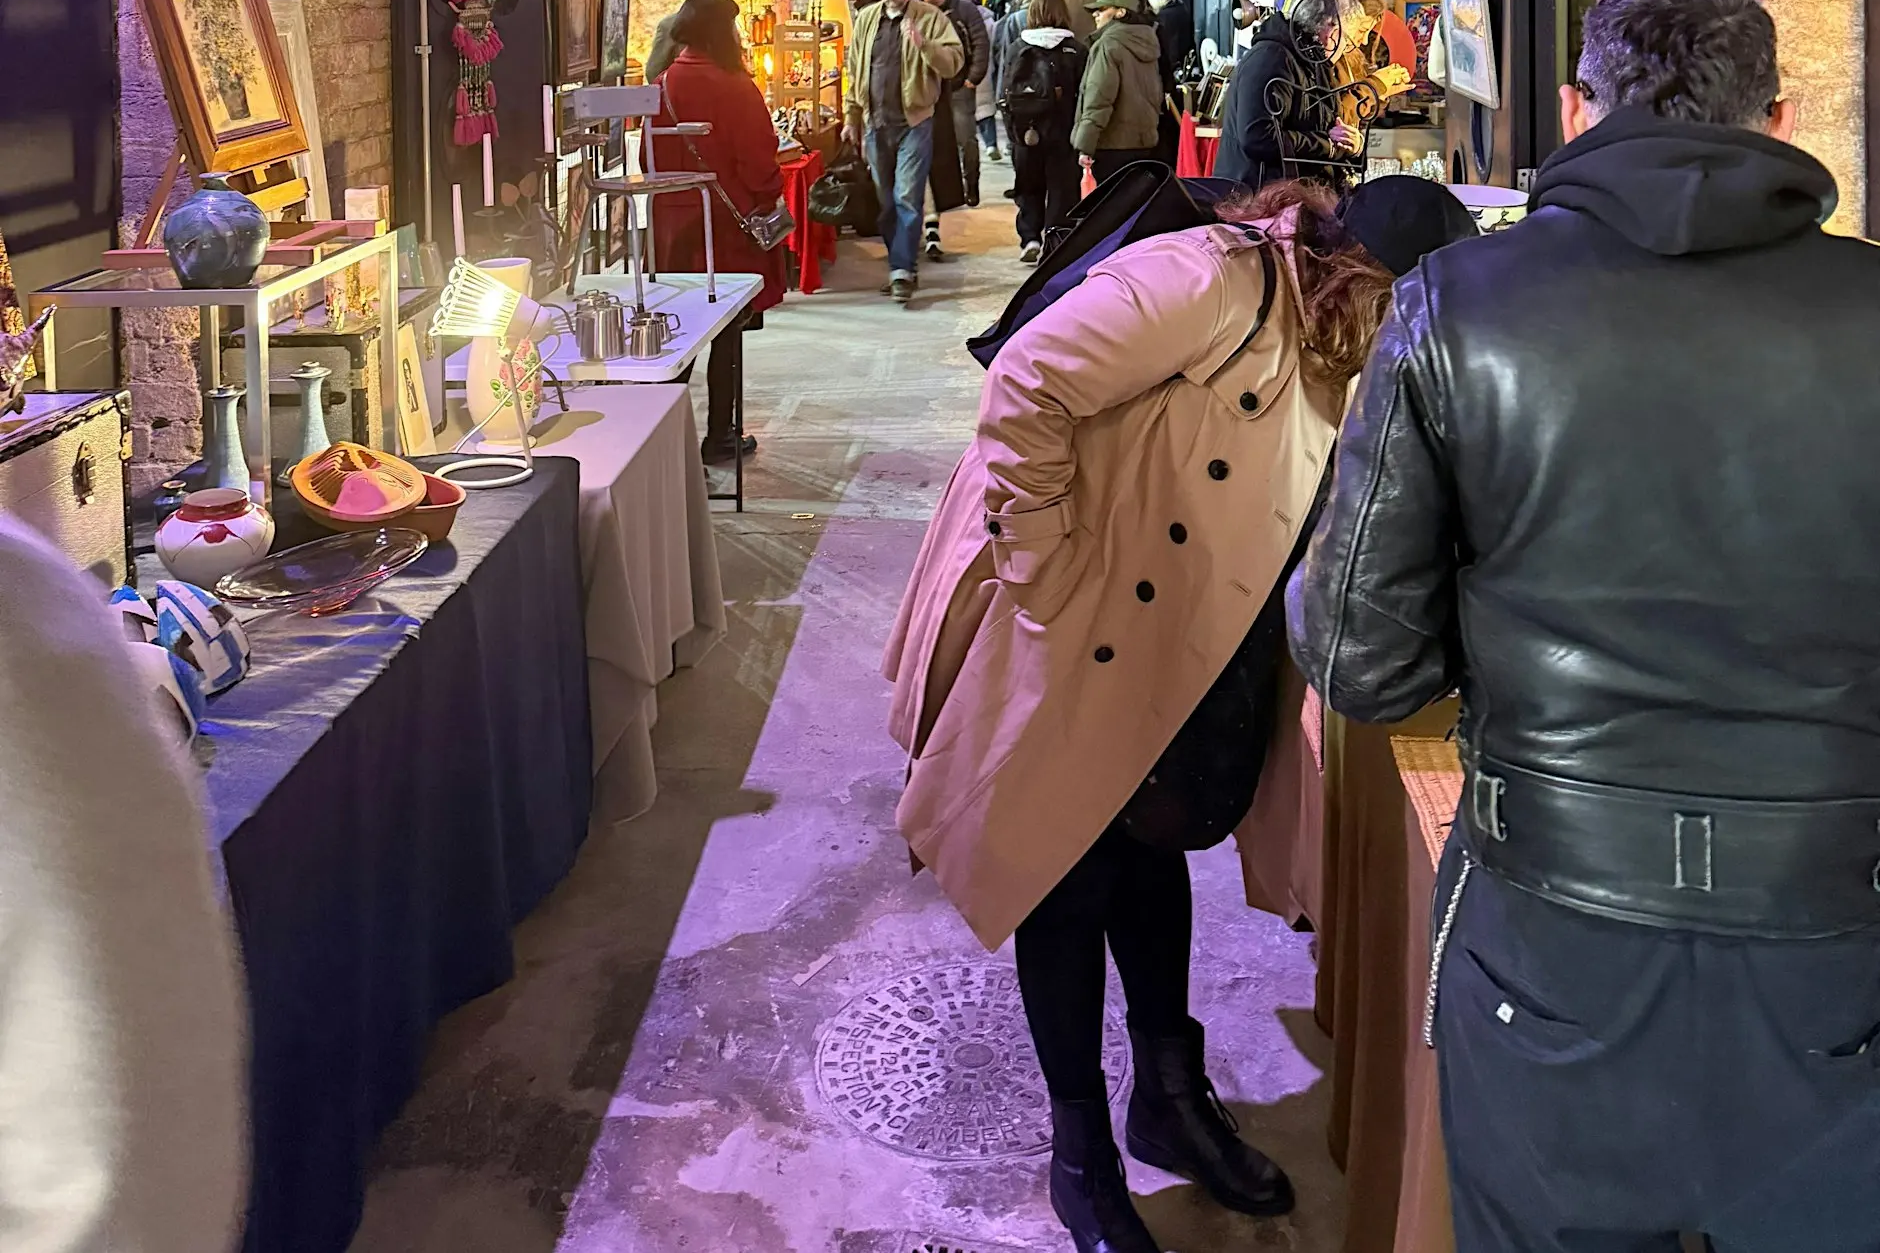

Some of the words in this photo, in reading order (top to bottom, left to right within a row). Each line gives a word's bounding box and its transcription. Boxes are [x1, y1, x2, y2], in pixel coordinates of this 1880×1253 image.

[886, 1024, 913, 1044] EN
[840, 1012, 884, 1113] INSPECTION
[880, 1052, 899, 1076] 124
[890, 1080, 959, 1115] CLASS
